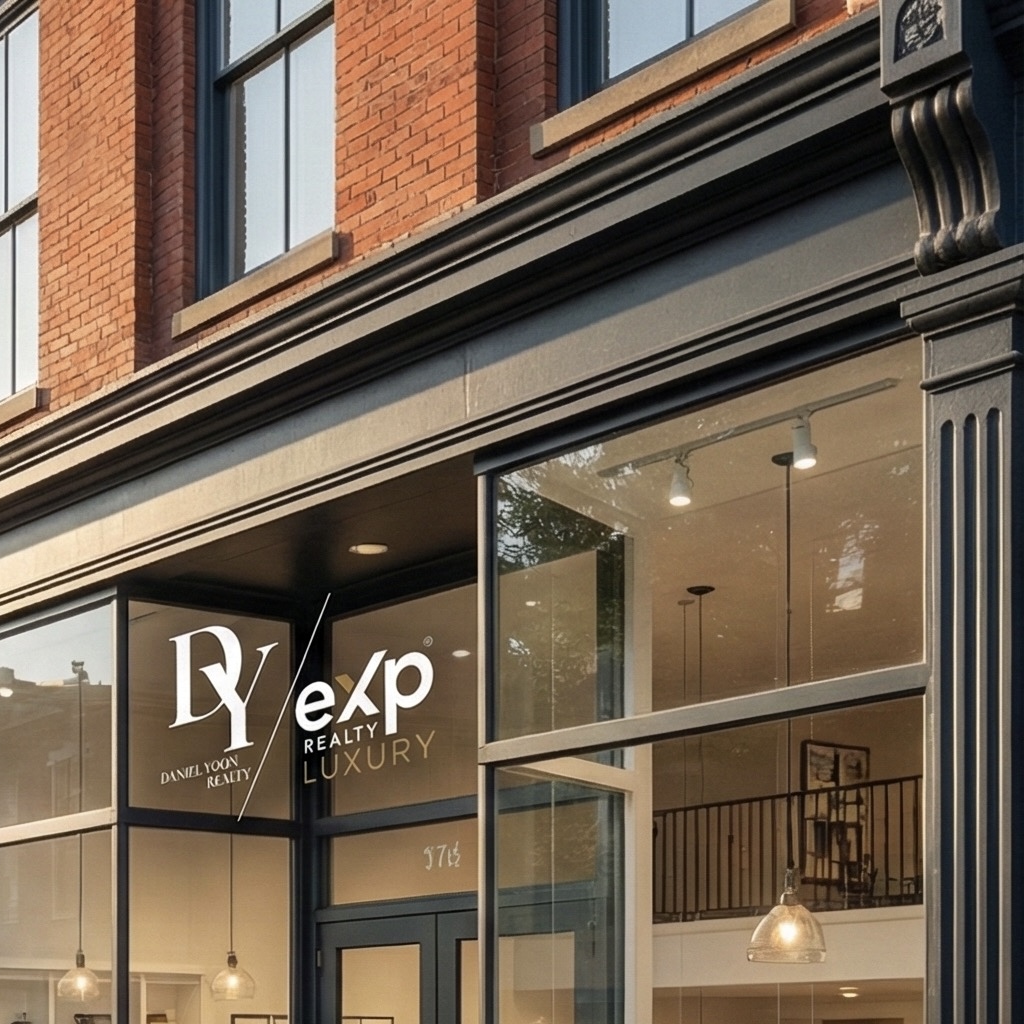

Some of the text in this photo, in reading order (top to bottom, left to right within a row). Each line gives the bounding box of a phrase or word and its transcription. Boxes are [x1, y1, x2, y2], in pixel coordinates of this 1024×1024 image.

[304, 722, 379, 754] REALTY
[160, 754, 239, 786] DANIEL YOON
[303, 730, 436, 785] LUXURY
[206, 766, 252, 790] REALTY
